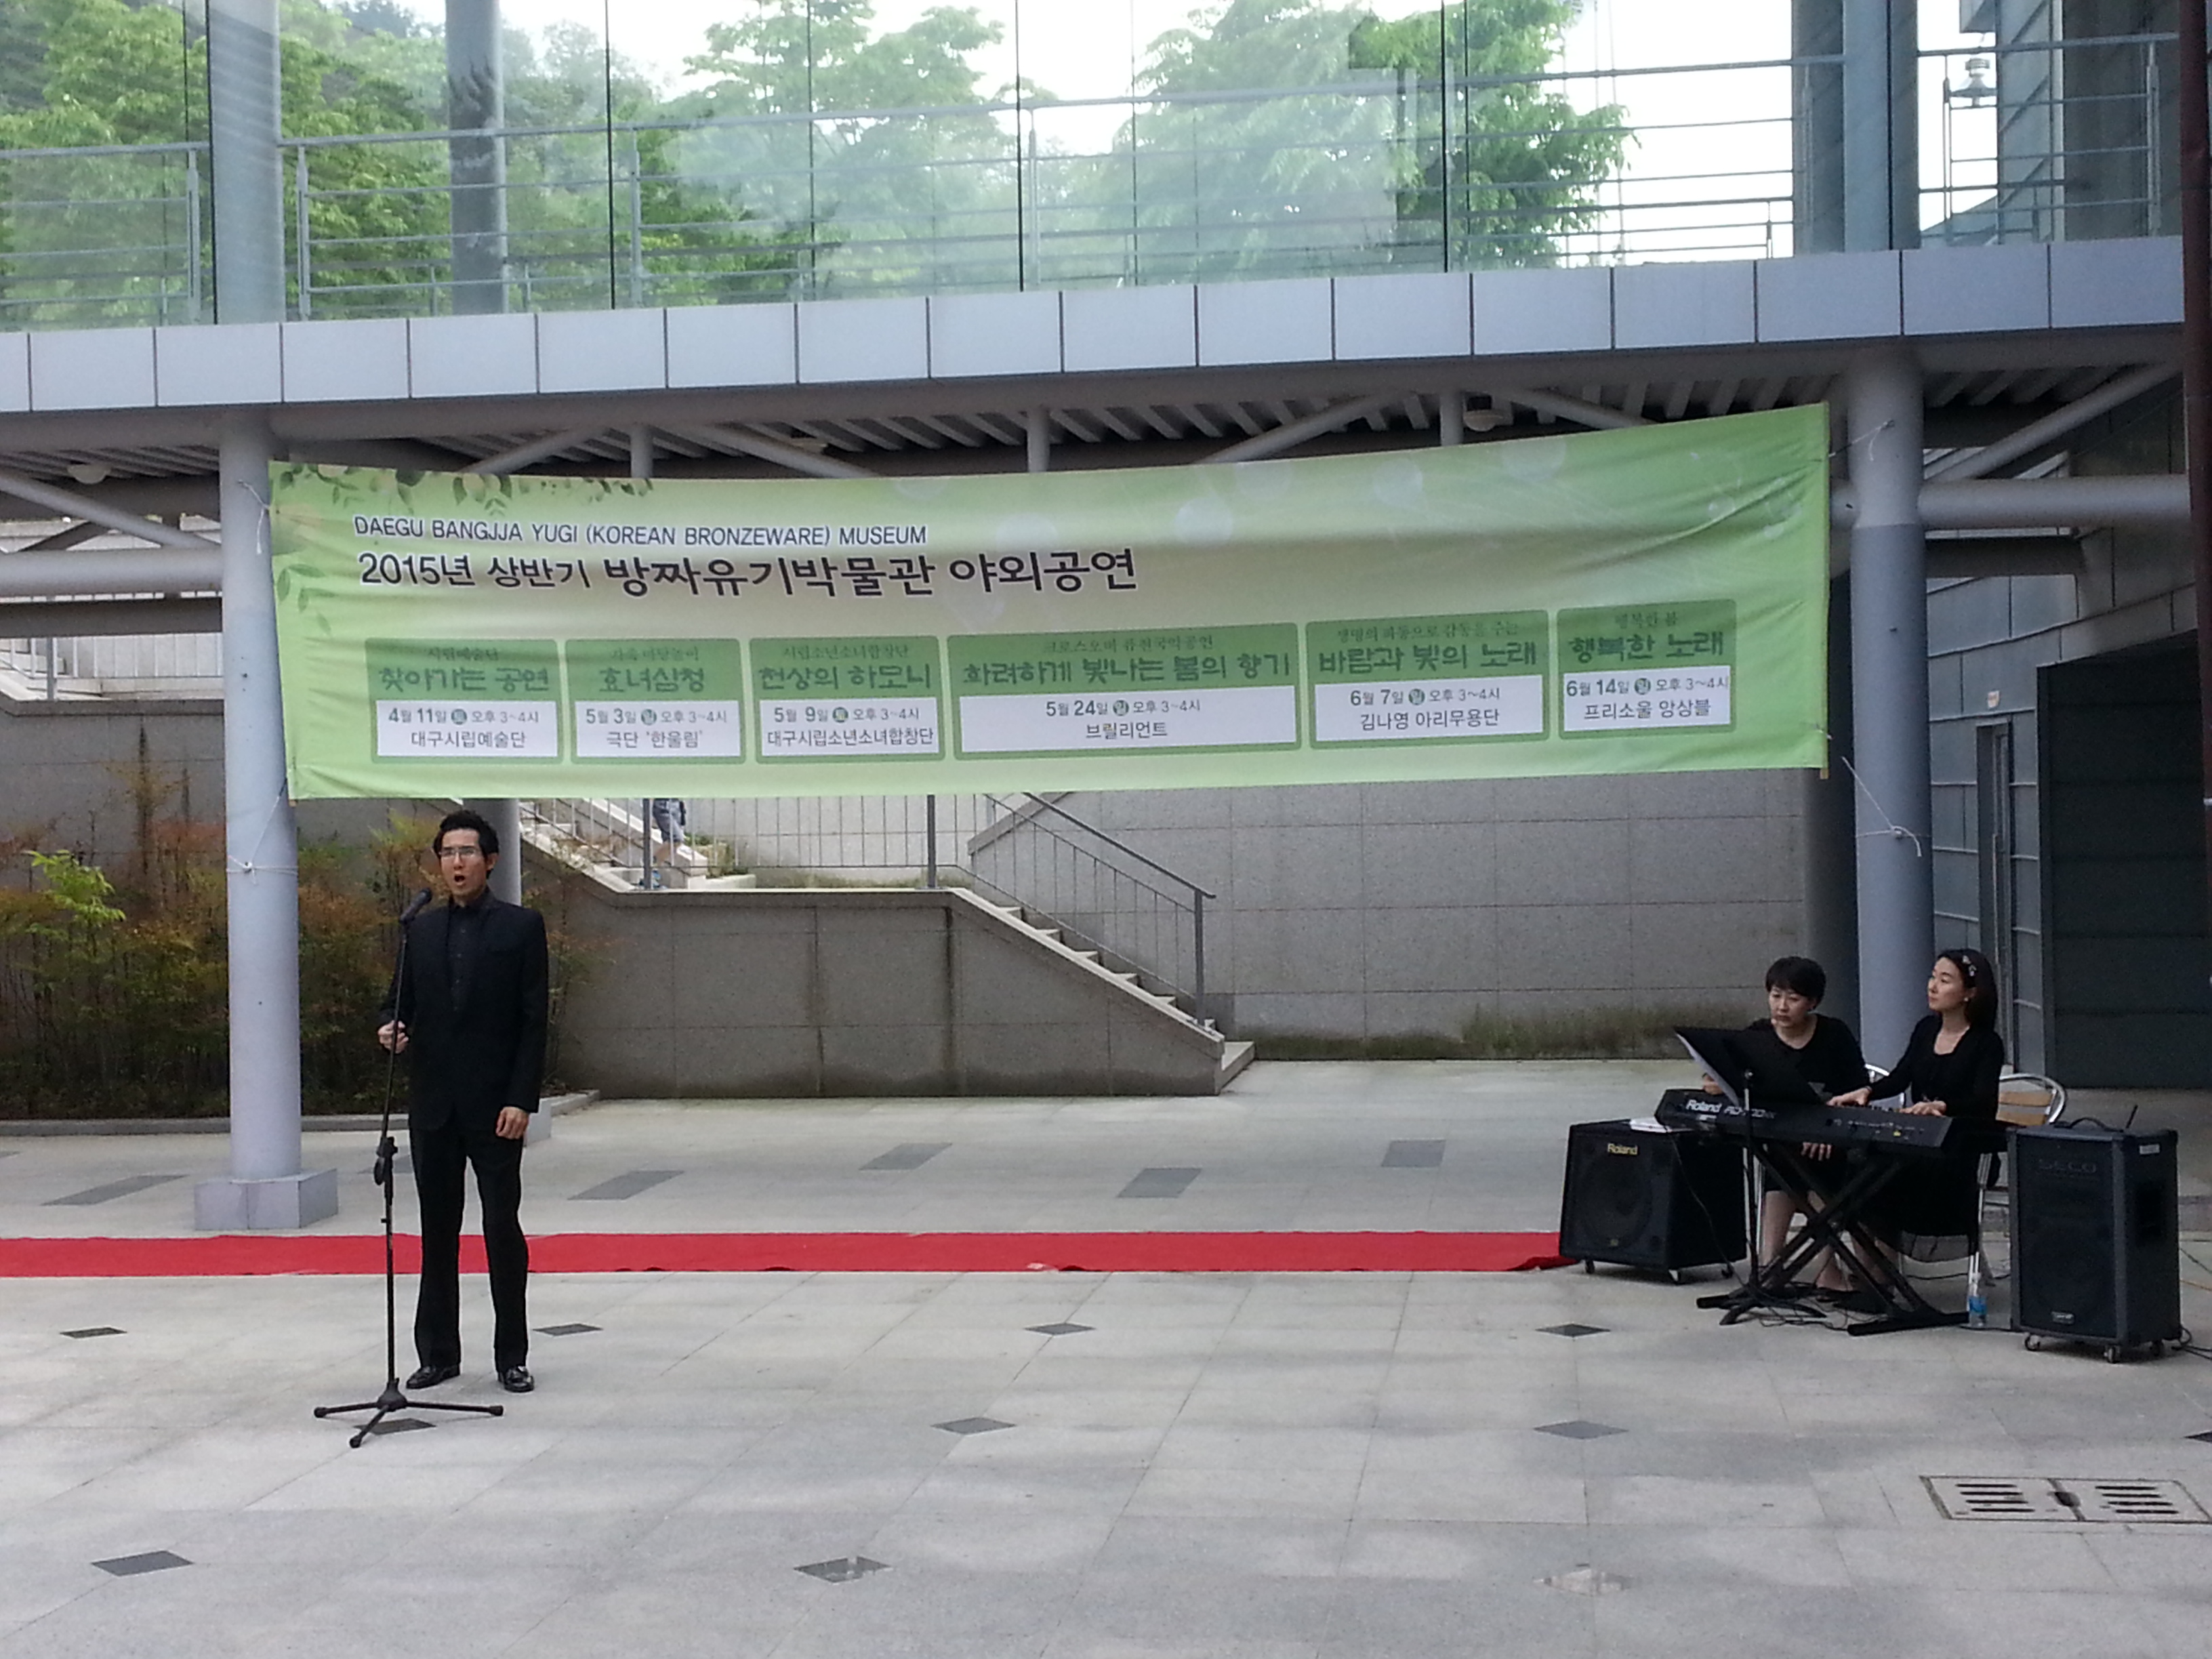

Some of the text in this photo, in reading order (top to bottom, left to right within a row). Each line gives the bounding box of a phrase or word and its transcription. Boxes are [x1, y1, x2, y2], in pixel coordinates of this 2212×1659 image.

[354, 516, 927, 546] DAEGU BANGJJA YUGI (KOREAN BRONZEWARE) MUSEUM
[359, 548, 1137, 597] 2015년 상반기 방짜유기박물관 야외공연
[1319, 642, 1536, 674] 바람과 빛의 노래
[1568, 631, 1723, 663] 행복한 노래
[379, 667, 550, 693] 찾아가는 공연
[599, 668, 705, 693] 효녀심청
[758, 663, 930, 691] 천상의 하모니
[963, 653, 1290, 685] 화려하게 빛나는 봄의 향기
[1360, 709, 1500, 731] 김나영 아리무용단
[1584, 699, 1711, 720] 프리소울 앙상블
[411, 731, 526, 748] 대구시립예술단
[607, 731, 638, 748] 극단
[767, 728, 934, 747] 대구시립소년소녀합창단
[1085, 721, 1168, 739] 브릴리언트
[1685, 1099, 1723, 1113] Roland
[1607, 1143, 1638, 1155] Roland
